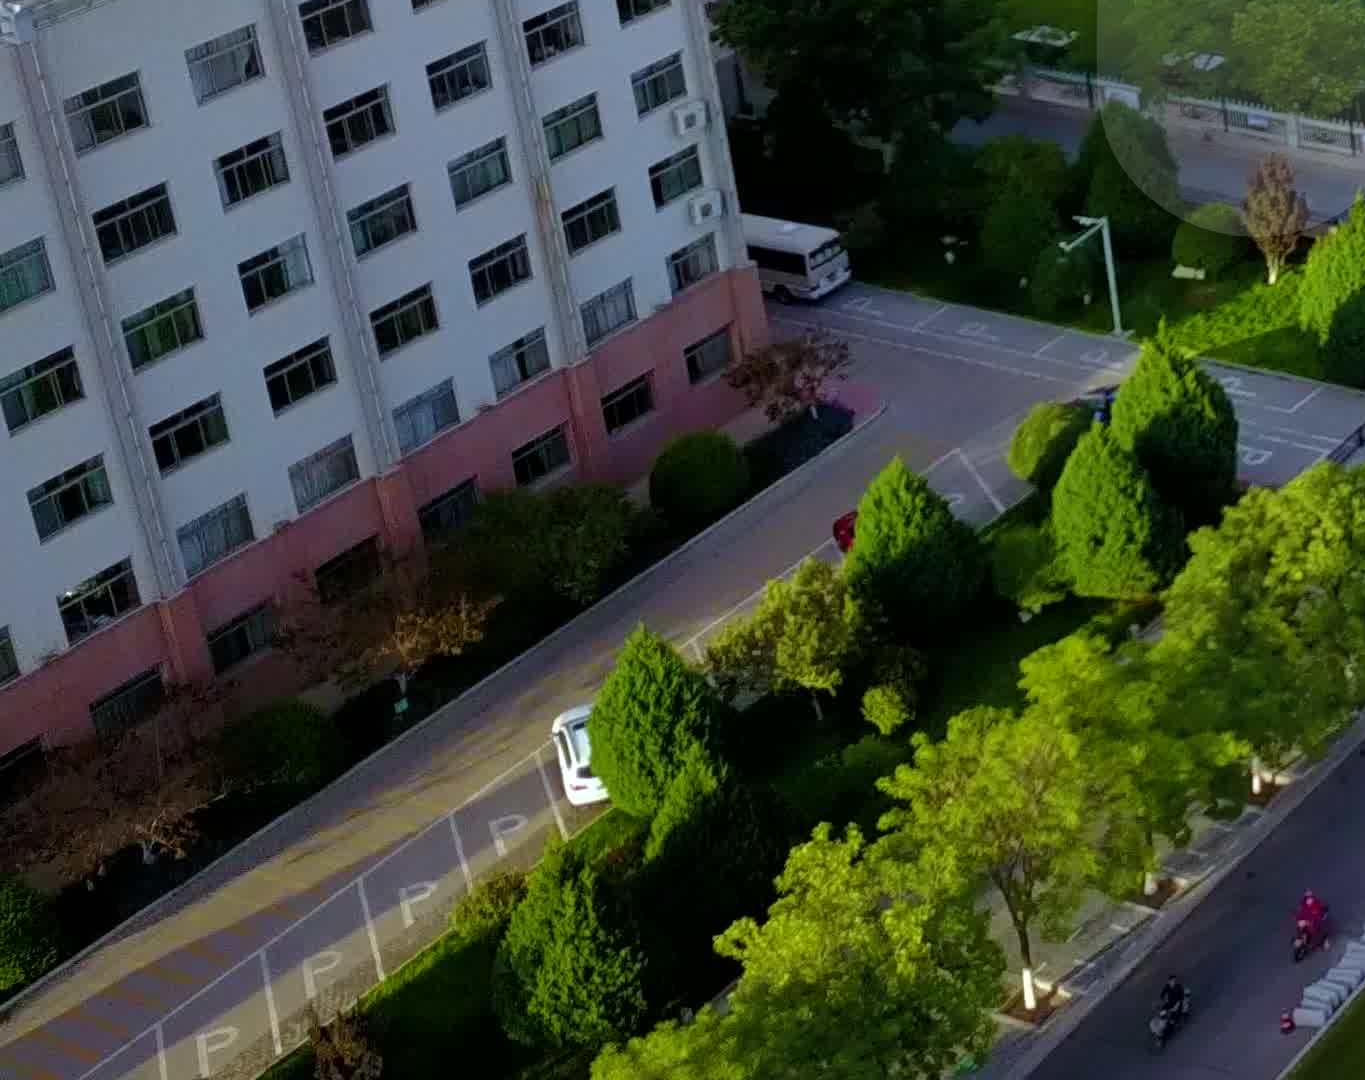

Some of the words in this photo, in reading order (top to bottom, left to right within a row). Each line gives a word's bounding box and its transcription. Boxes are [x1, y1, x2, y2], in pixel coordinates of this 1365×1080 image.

[487, 814, 528, 857] P
[398, 880, 439, 928] P
[303, 950, 342, 999] P
[196, 1025, 240, 1078] P
